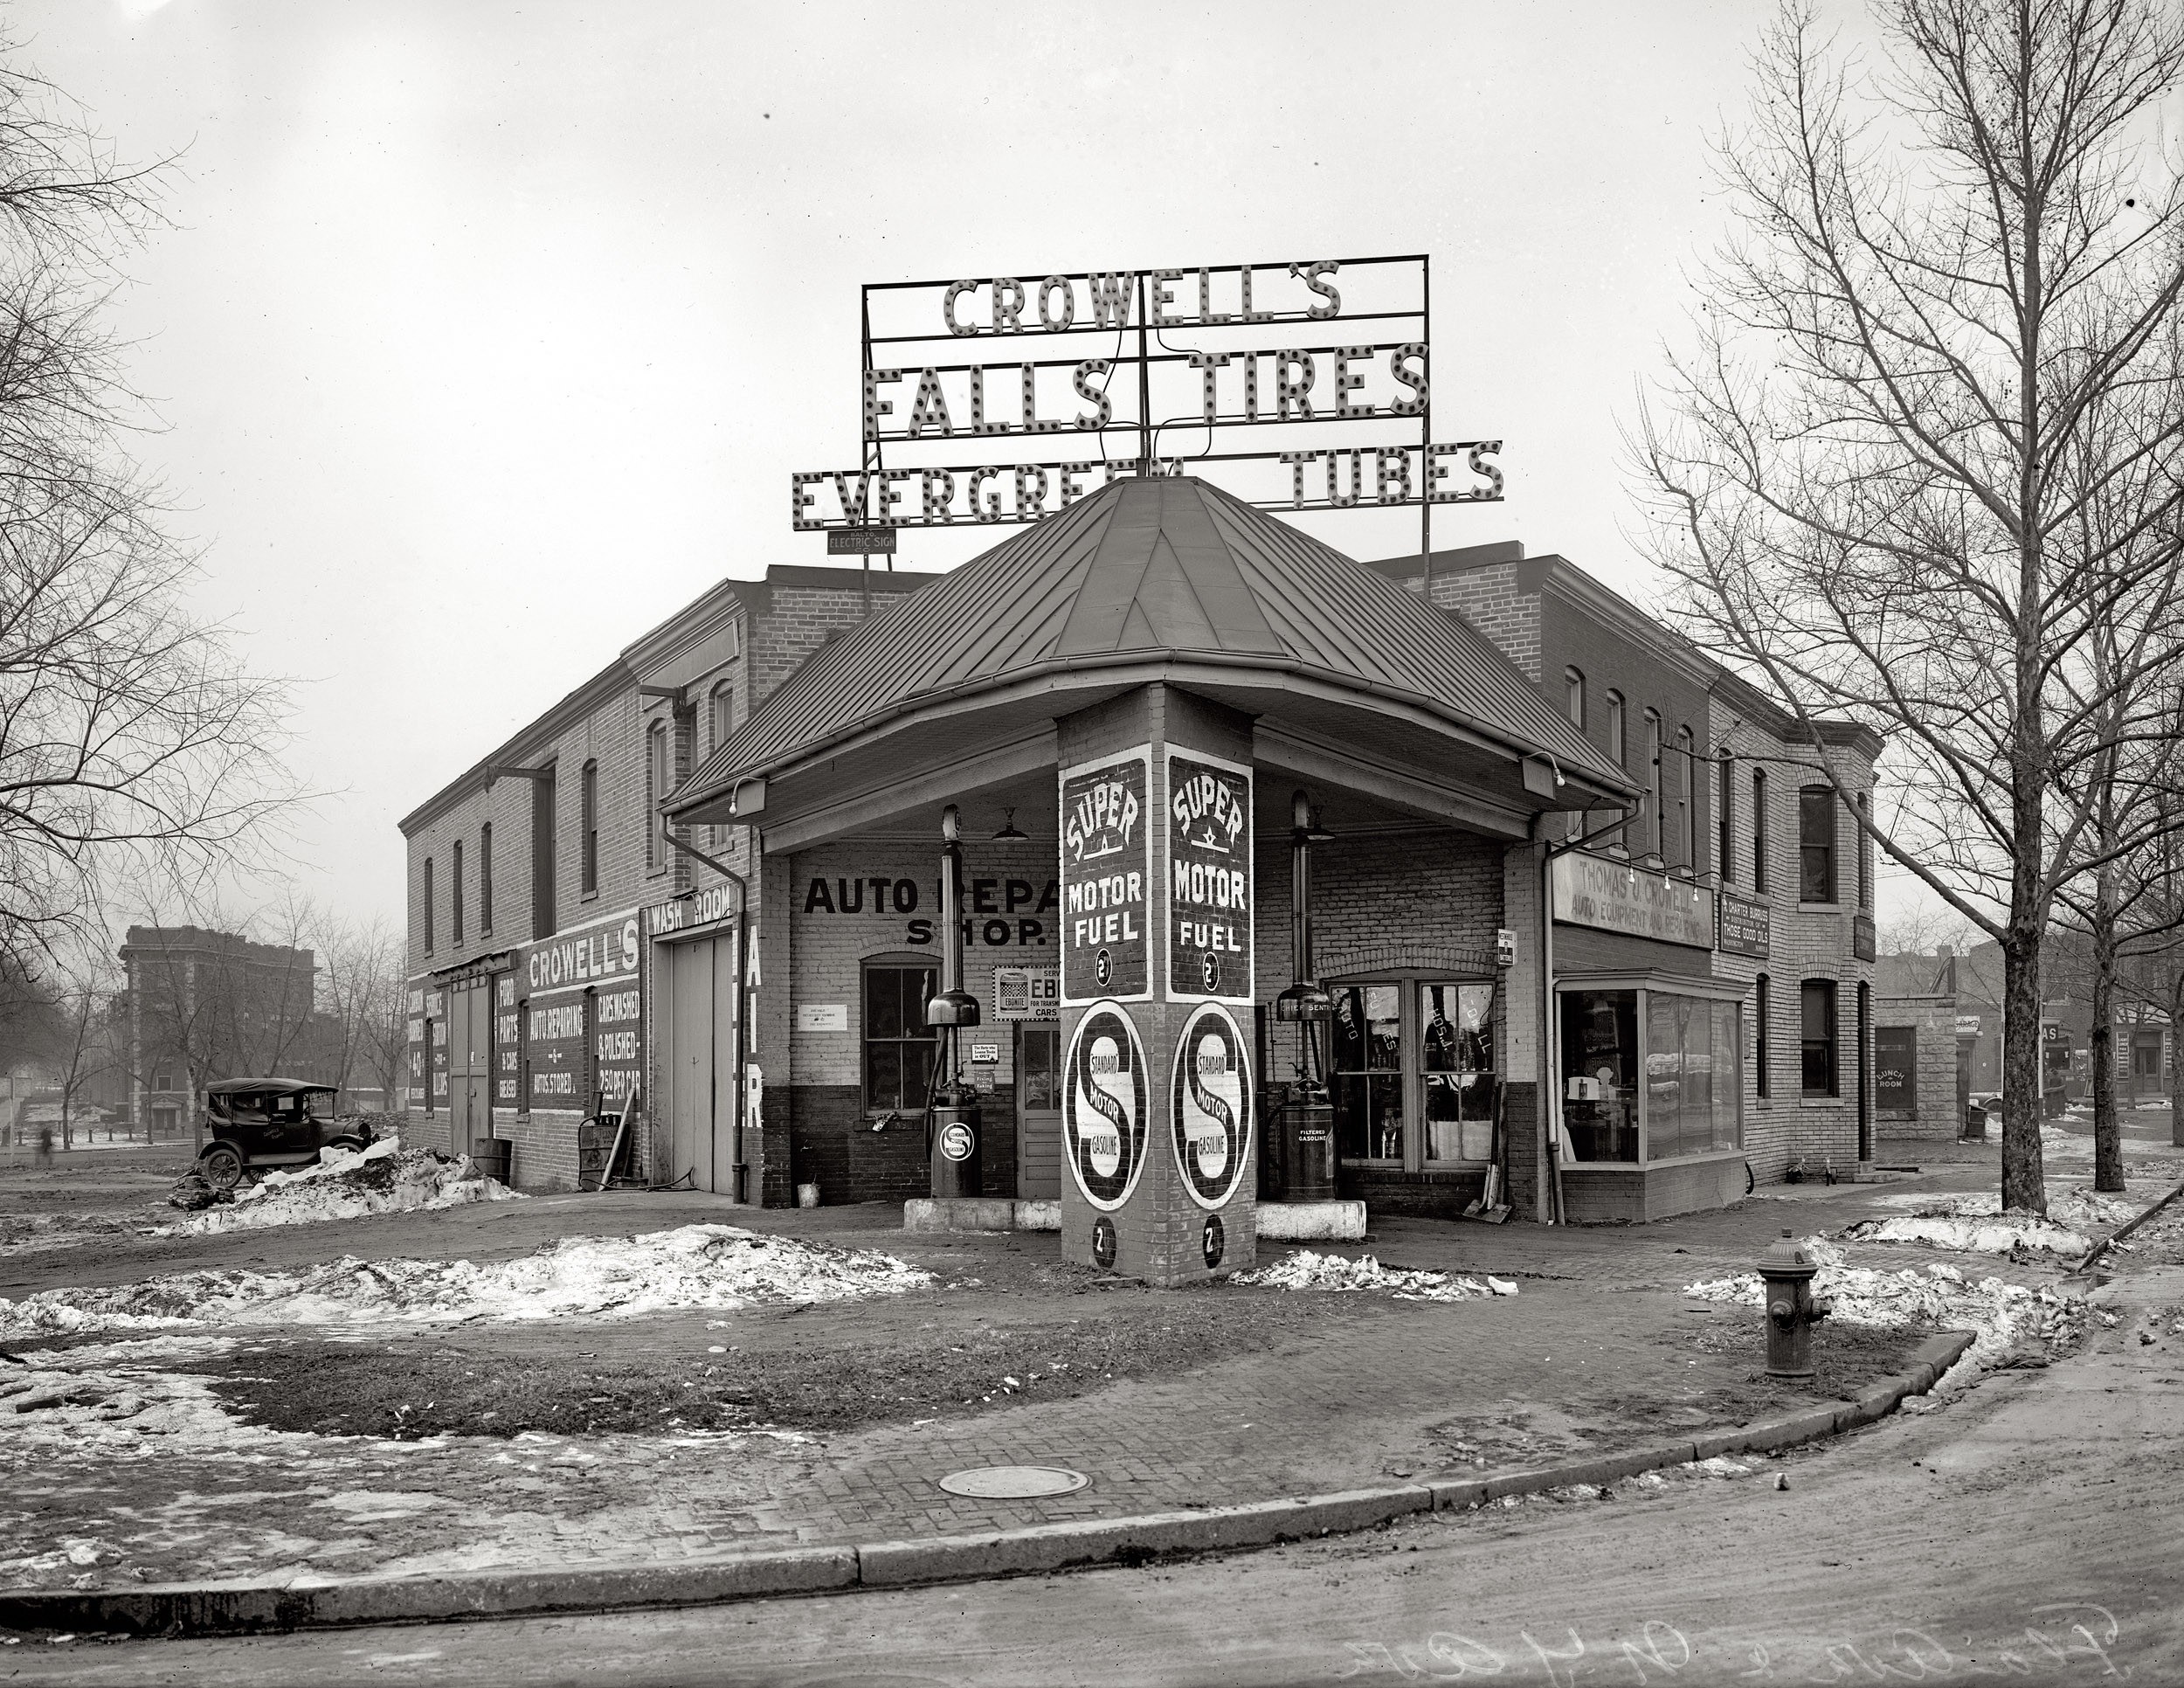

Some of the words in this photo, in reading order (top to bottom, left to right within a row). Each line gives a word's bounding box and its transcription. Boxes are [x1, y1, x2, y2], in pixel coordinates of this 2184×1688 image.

[943, 260, 1341, 337] CROWELL'S
[865, 358, 1113, 441] FALLS
[1188, 342, 1430, 425] TIRES
[792, 456, 1185, 531] EVERGRE
[1280, 440, 1504, 510] TUBES
[829, 537, 871, 548] ELECTRIC
[874, 536, 895, 547] SIGN
[1067, 781, 1139, 861] SUPER
[1173, 775, 1242, 847] SUPER
[803, 877, 918, 914] AUTO
[937, 878, 1061, 914] EPA
[1068, 872, 1142, 915] MOTOR
[1174, 860, 1246, 910] MOTOR
[1579, 861, 1628, 900] THOMAS
[1644, 879, 1693, 916] CROWELL
[651, 900, 682, 935] WASH
[694, 885, 730, 926] ROOM
[1572, 894, 1596, 917] AUTO
[1600, 900, 1648, 929] EQUIPMENT
[1075, 911, 1139, 948] FUEL
[1180, 921, 1241, 952] FUEL
[1724, 923, 1741, 938] THOSE
[1742, 927, 1757, 941] GOOD
[1757, 930, 1768, 944] OILS
[529, 919, 639, 987] CROWELL'S
[500, 978, 515, 1007] FORD
[614, 990, 640, 1020] WASHED
[500, 1013, 518, 1043] PARTS
[548, 1004, 584, 1040] REPAIRING
[598, 1034, 605, 1061] &
[549, 1072, 571, 1094] STORED
[613, 1070, 625, 1100] PER
[626, 1069, 640, 1100] CAR
[1876, 1069, 1905, 1081] LUNCH
[1089, 1081, 1120, 1124] MOTOR
[1197, 1081, 1227, 1125] MOTOR
[1092, 1136, 1117, 1156] GASOLINE
[1198, 1136, 1225, 1156] GASOLINE
